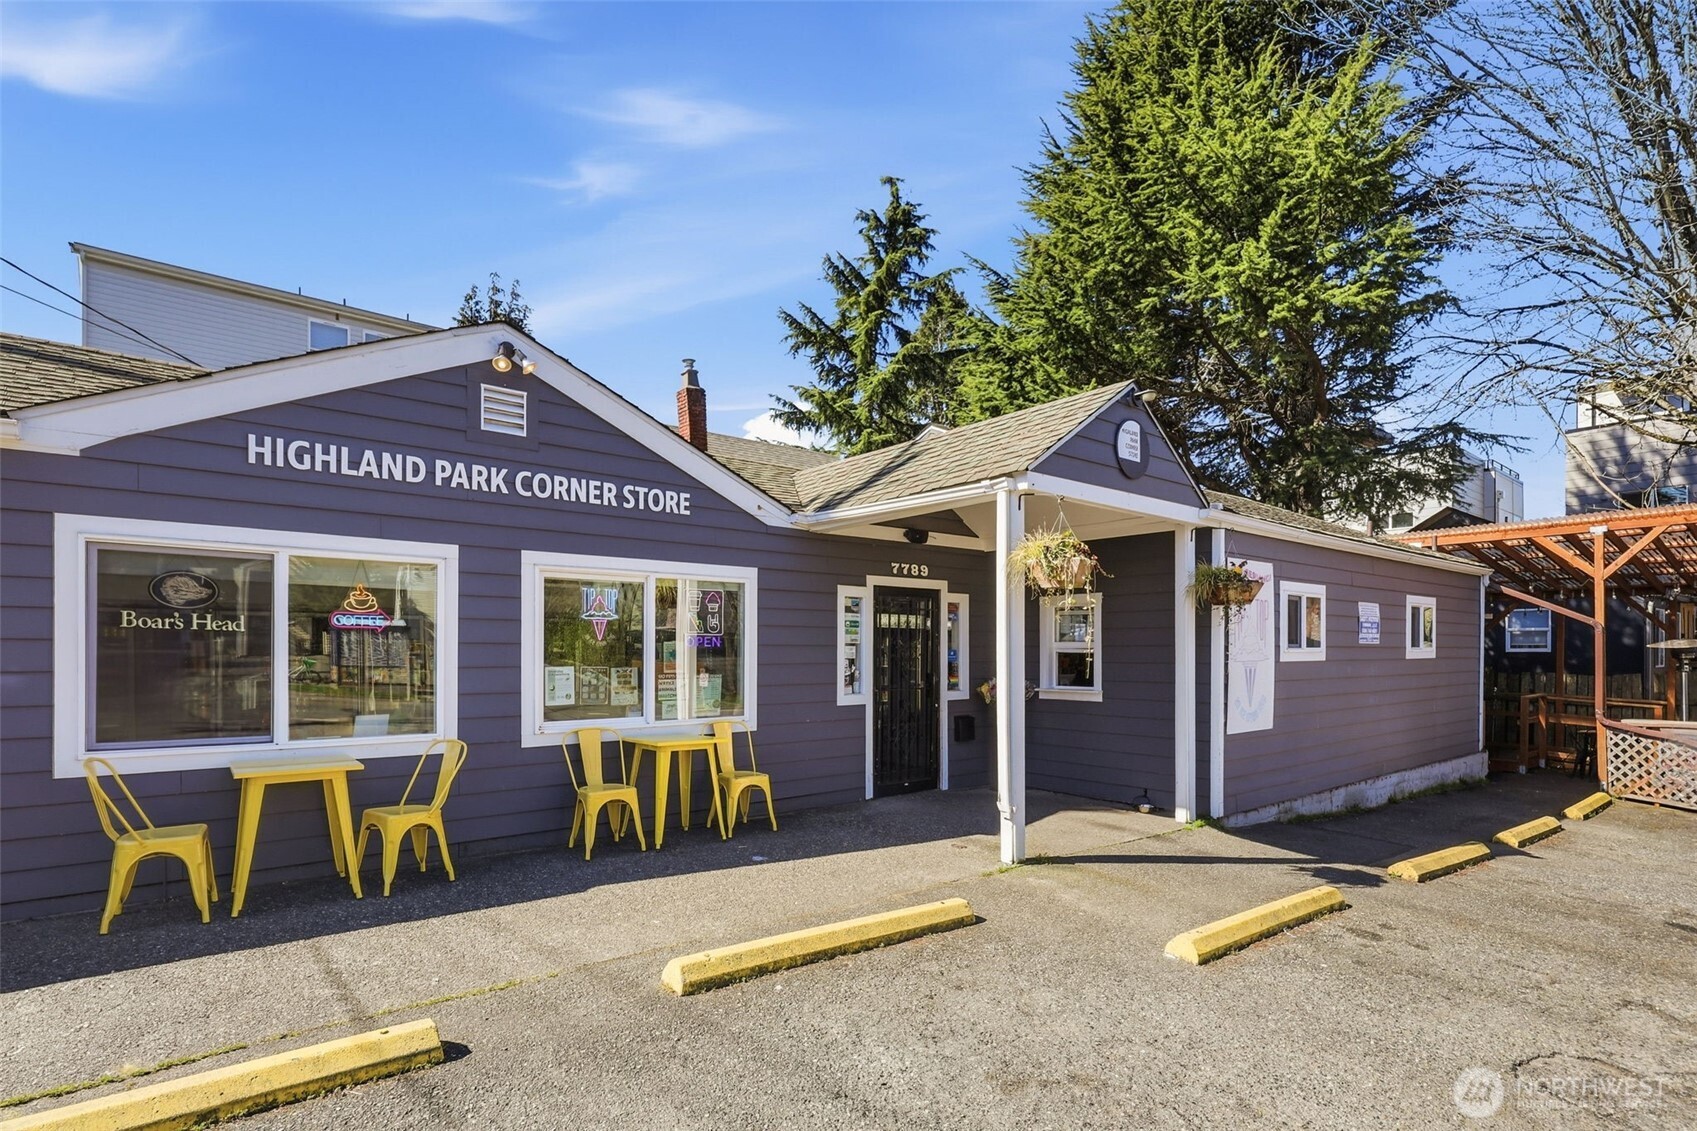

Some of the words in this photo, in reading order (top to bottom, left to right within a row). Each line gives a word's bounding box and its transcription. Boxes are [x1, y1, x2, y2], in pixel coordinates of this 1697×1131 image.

[247, 433, 427, 484] HIGHLAND
[434, 459, 509, 494] PARK
[515, 470, 618, 507] CORNER
[622, 485, 691, 516] STORE
[891, 562, 928, 576] 7789
[119, 609, 184, 630] Boar's
[190, 612, 246, 633] Head
[333, 614, 386, 627] COFFEE
[687, 636, 721, 648] OPEN
